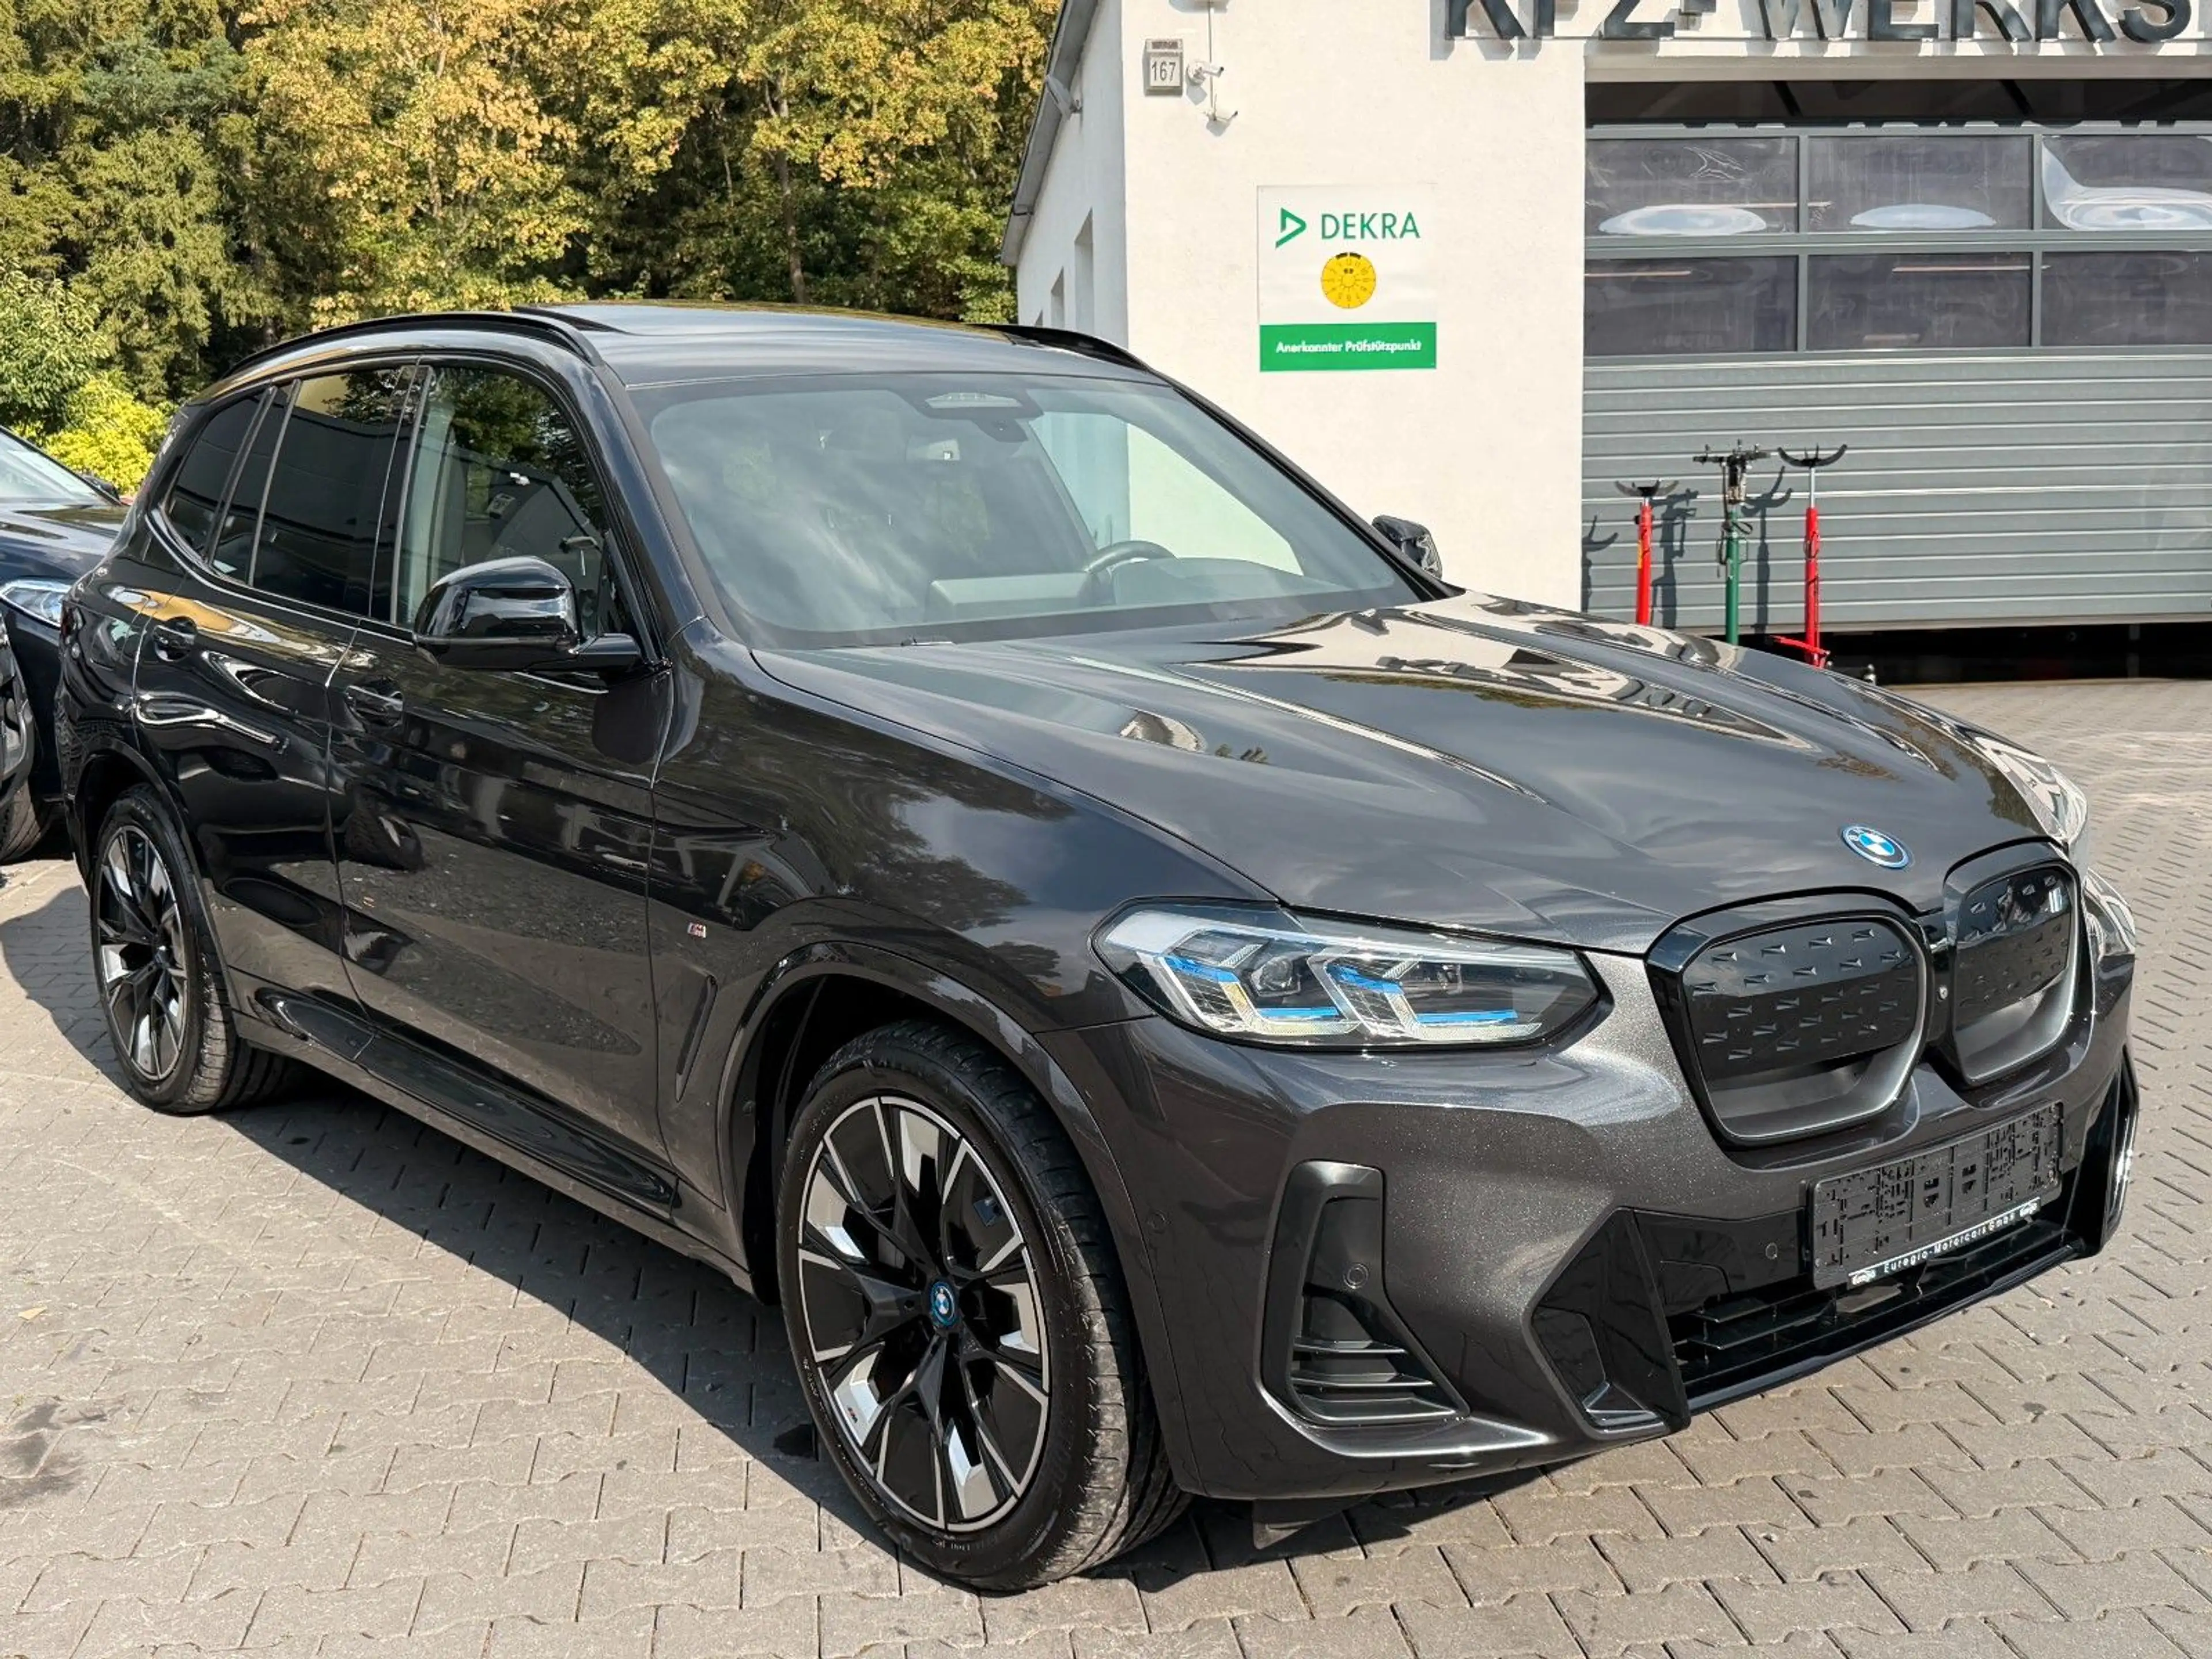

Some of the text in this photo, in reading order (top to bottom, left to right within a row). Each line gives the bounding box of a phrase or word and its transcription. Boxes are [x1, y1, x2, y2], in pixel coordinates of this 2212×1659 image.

[1152, 60, 1176, 81] 167
[1321, 211, 1421, 240] DEKRA
[1276, 339, 1422, 353] Anerkannter Prüfstützpunkt
